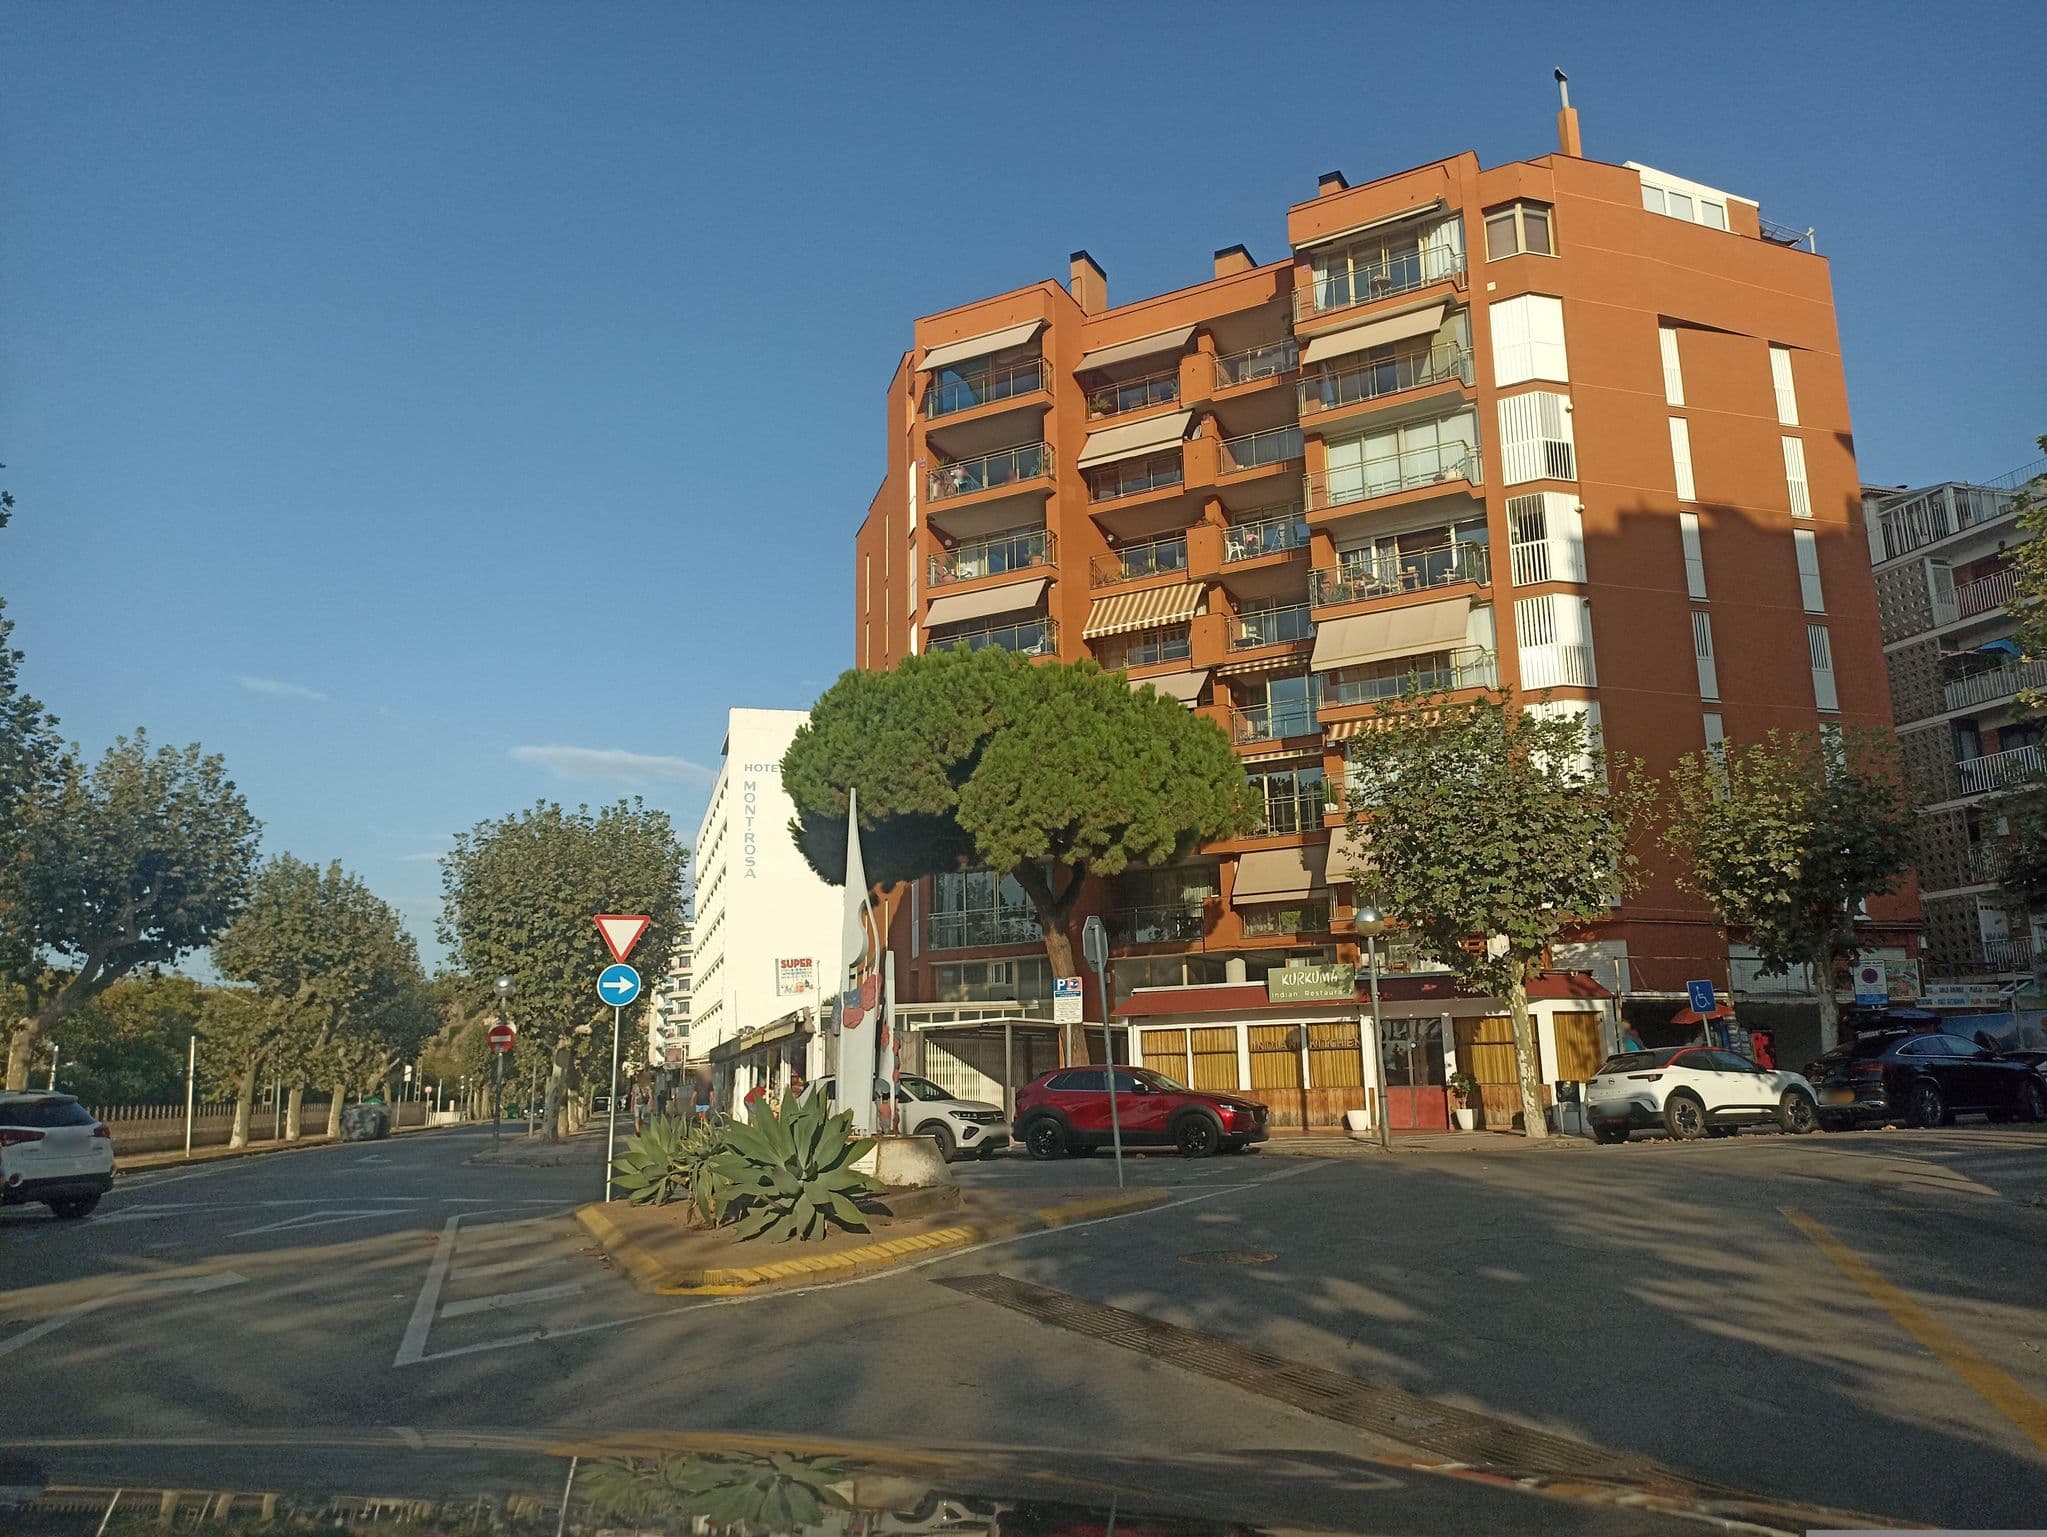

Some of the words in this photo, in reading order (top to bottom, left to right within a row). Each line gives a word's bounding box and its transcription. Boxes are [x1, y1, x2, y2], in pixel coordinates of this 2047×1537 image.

[780, 958, 813, 968] SUPER
[1281, 969, 1338, 986] KURKUMA
[1057, 979, 1066, 991] P
[1271, 991, 1298, 999] Indian
